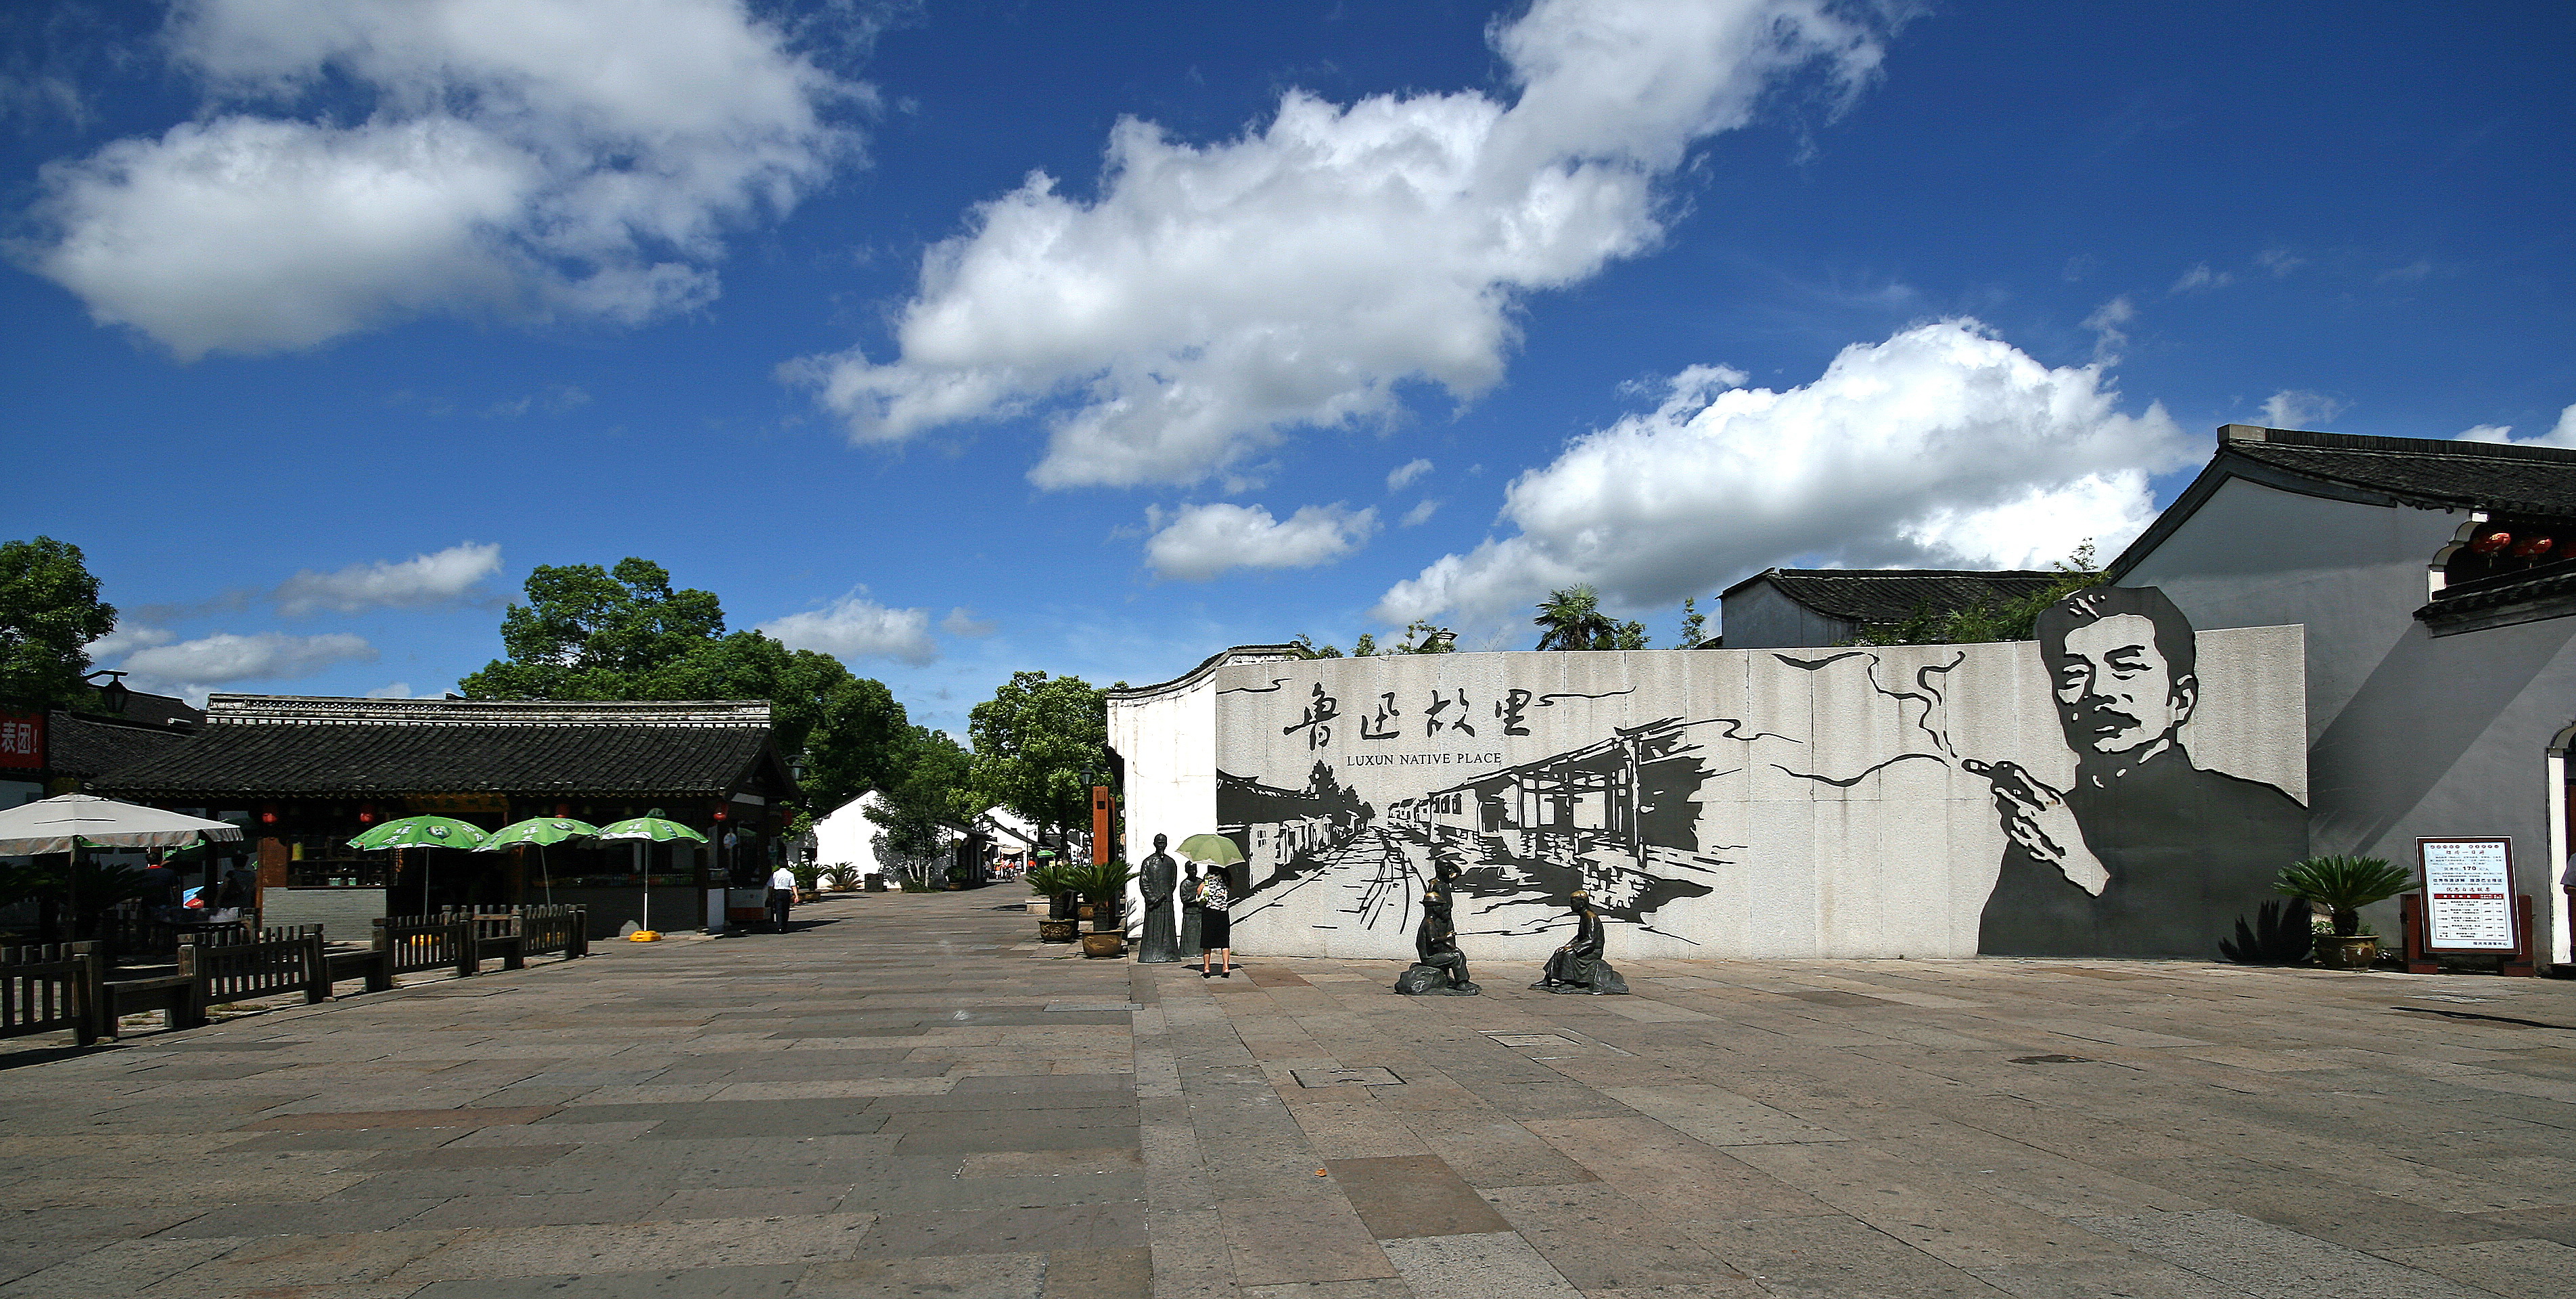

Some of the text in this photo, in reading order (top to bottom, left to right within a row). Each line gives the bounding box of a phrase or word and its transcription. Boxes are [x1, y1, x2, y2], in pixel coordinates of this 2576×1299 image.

[1283, 681, 1532, 751] 鲁迅故里
[1347, 752, 1502, 767] LUXUN NATIVE PLACE
